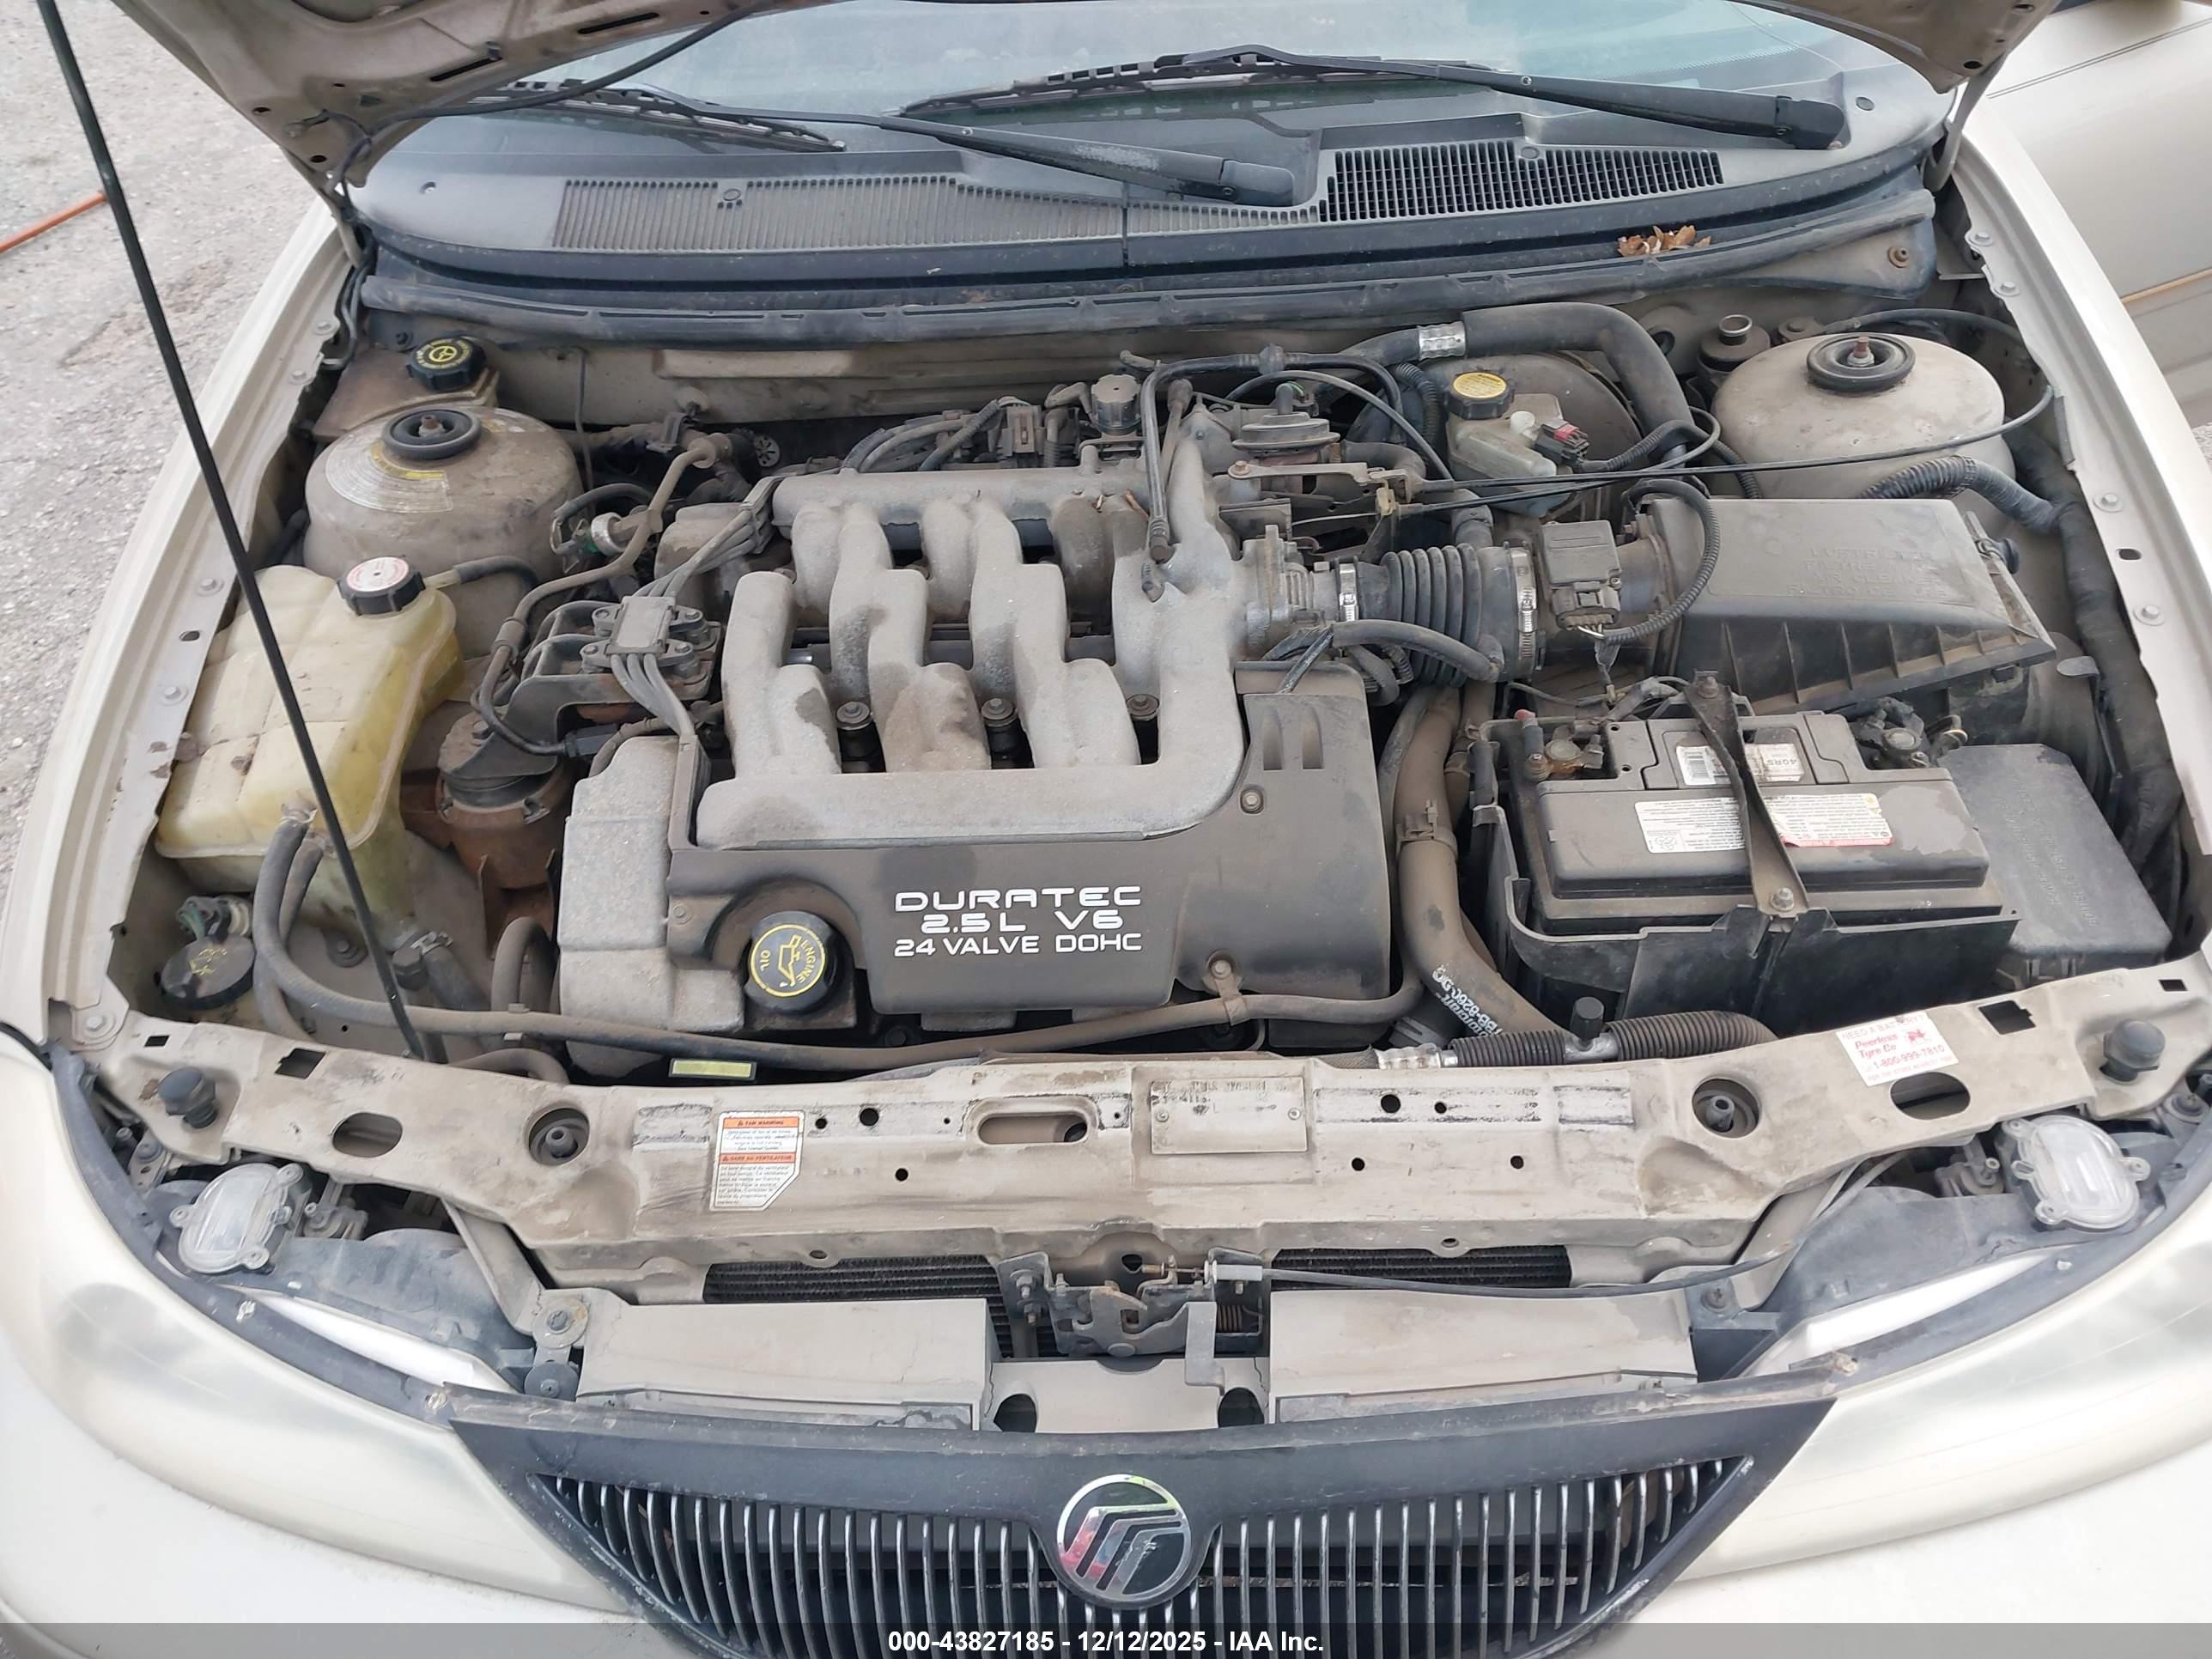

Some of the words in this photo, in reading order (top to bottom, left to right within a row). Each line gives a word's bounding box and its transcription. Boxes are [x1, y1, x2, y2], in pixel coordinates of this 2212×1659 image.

[895, 886, 1141, 912] DURATEC
[1054, 909, 1124, 930] V6
[894, 938, 937, 957] 24
[942, 934, 1040, 955] VALVE
[1055, 933, 1142, 953] DOHC
[759, 949, 771, 973] OIL
[795, 939, 817, 984] ENGINE
[1440, 993, 1489, 1038] otorcraft
[1855, 1033, 1898, 1049] Peerless
[1873, 1044, 1946, 1070] 1-800-999-7810
